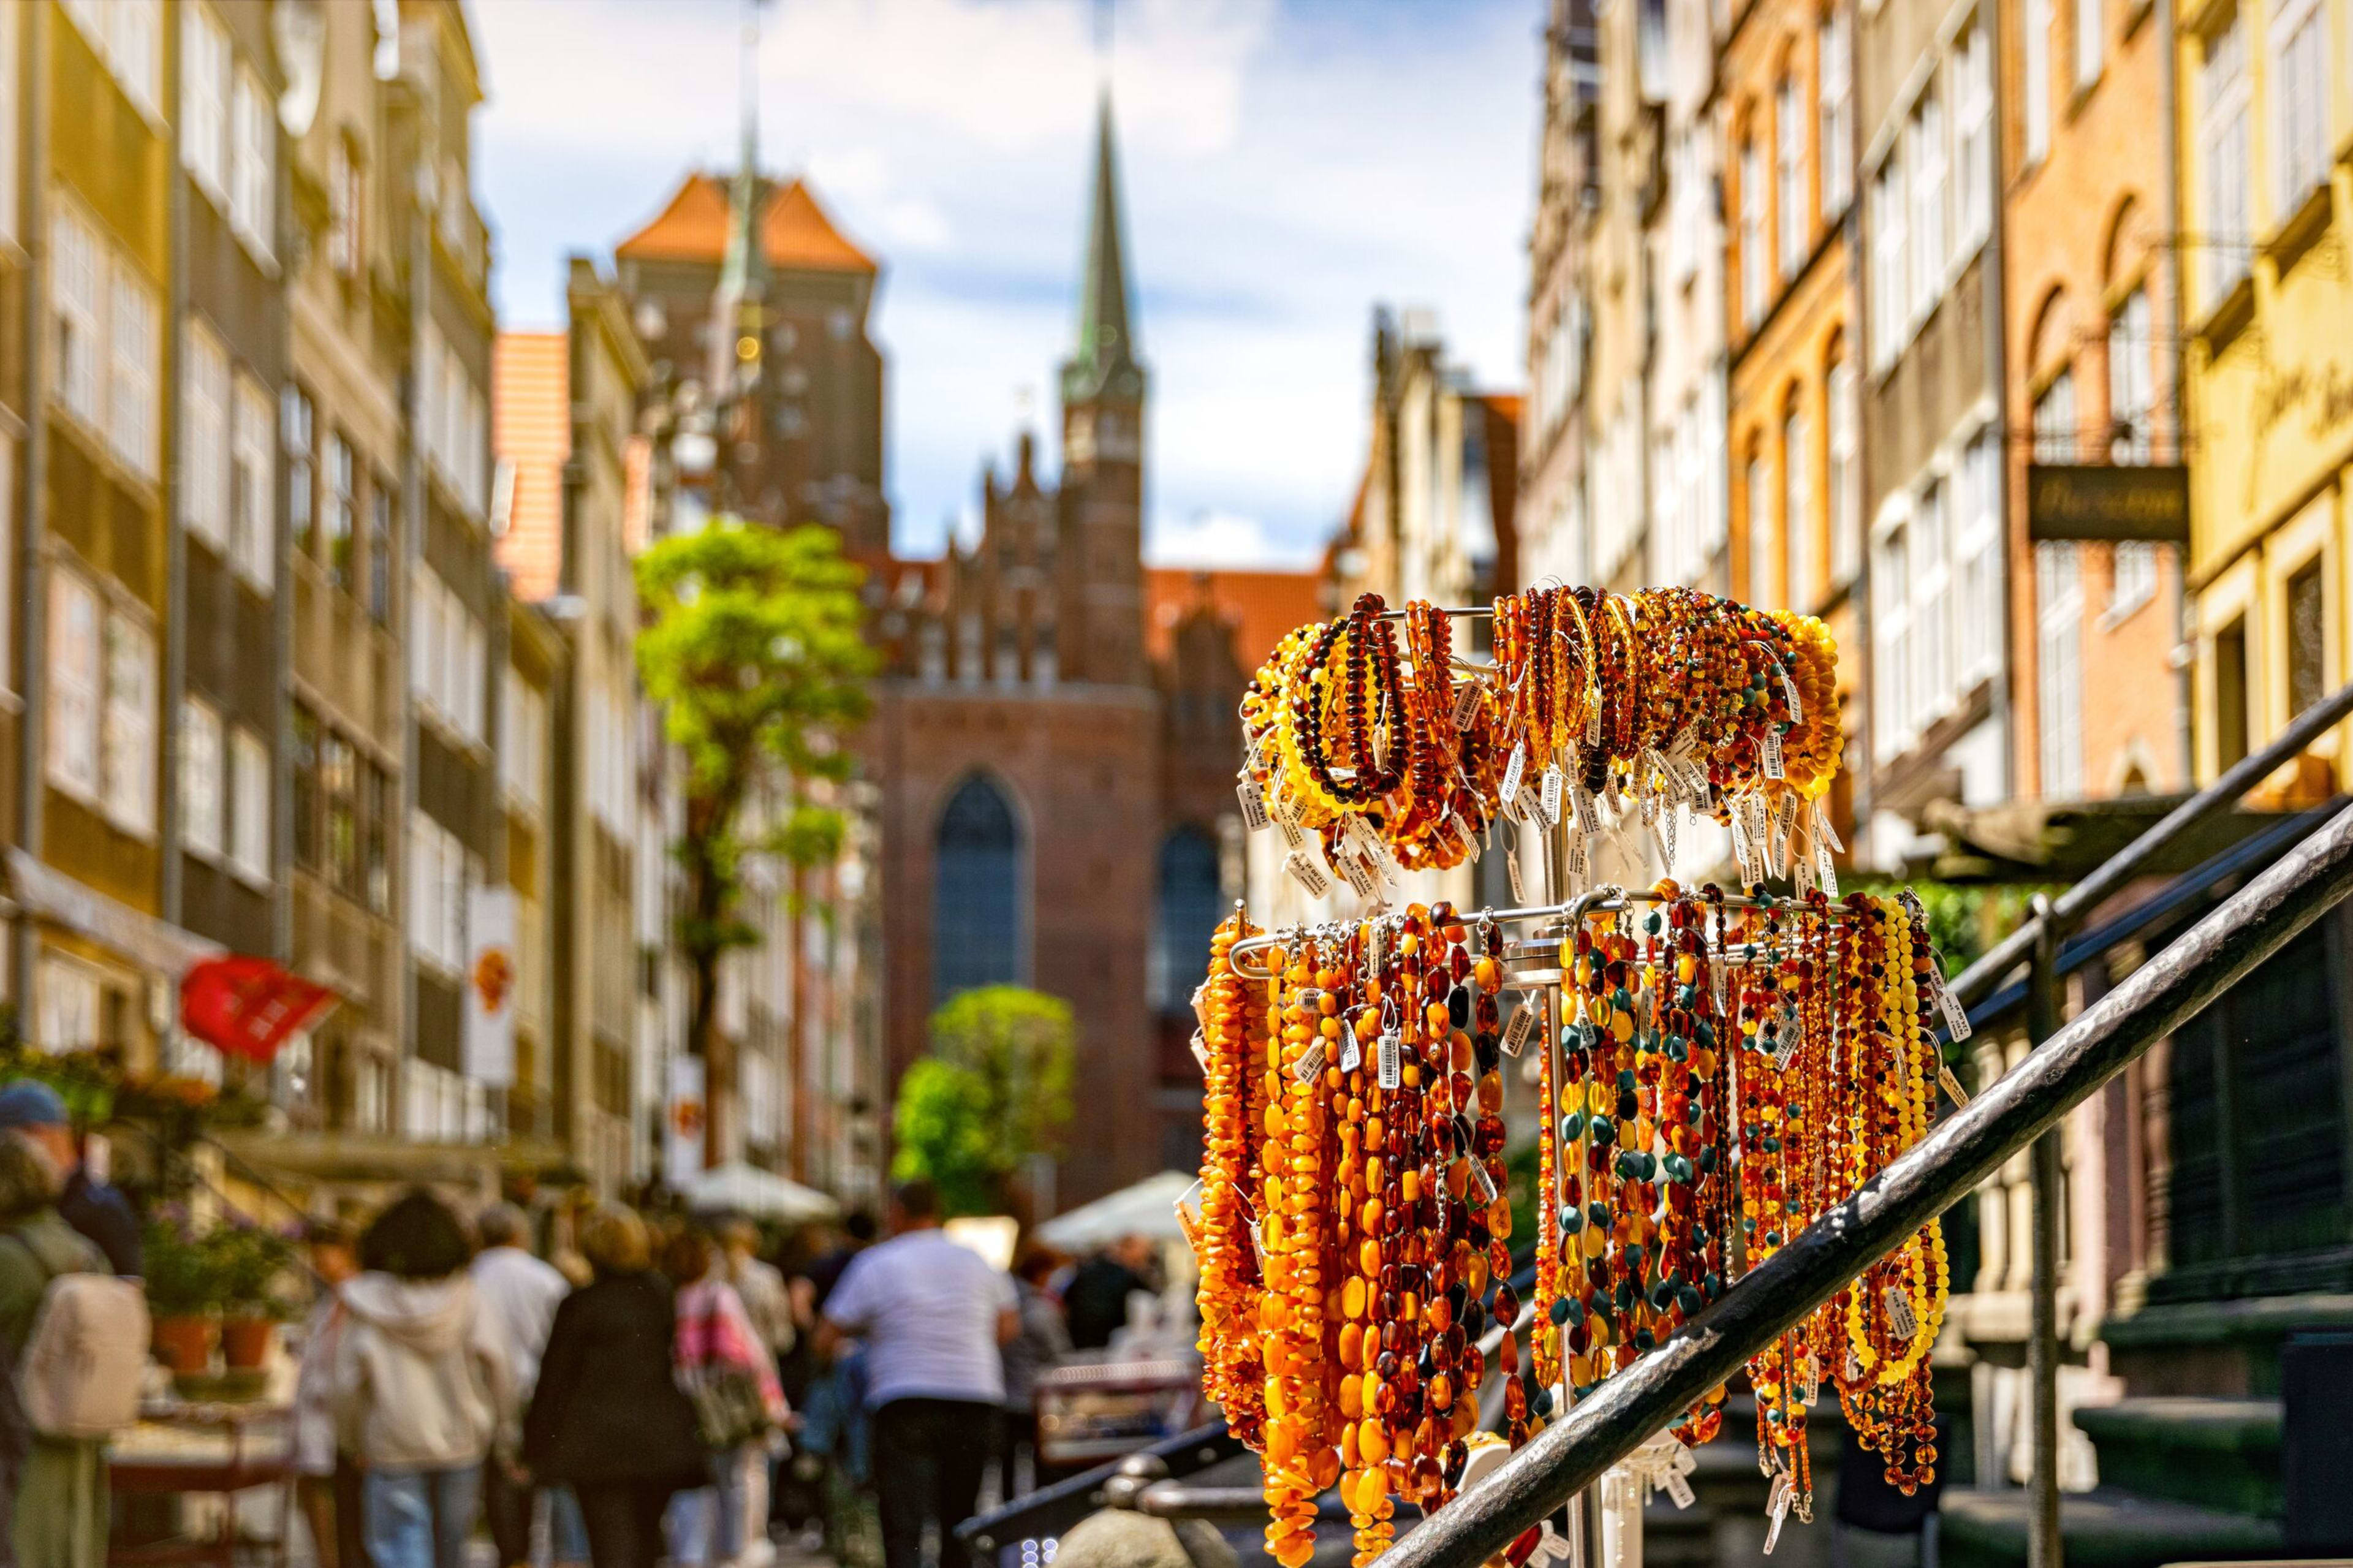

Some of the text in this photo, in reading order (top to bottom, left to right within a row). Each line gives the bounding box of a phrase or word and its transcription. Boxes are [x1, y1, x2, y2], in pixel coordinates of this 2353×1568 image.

[1469, 699, 1479, 714] Venus
[1463, 714, 1472, 729] Group
[1251, 805, 1260, 825] Bursztyn
[1257, 801, 1267, 822] 168,00
[1590, 809, 1599, 831] 273,00
[1308, 874, 1322, 892] Bursztyn
[1311, 868, 1327, 887] 122,00
[1357, 870, 1373, 890] 203,00
[1519, 1024, 1528, 1039] Venus
[1512, 1039, 1521, 1055] Group
